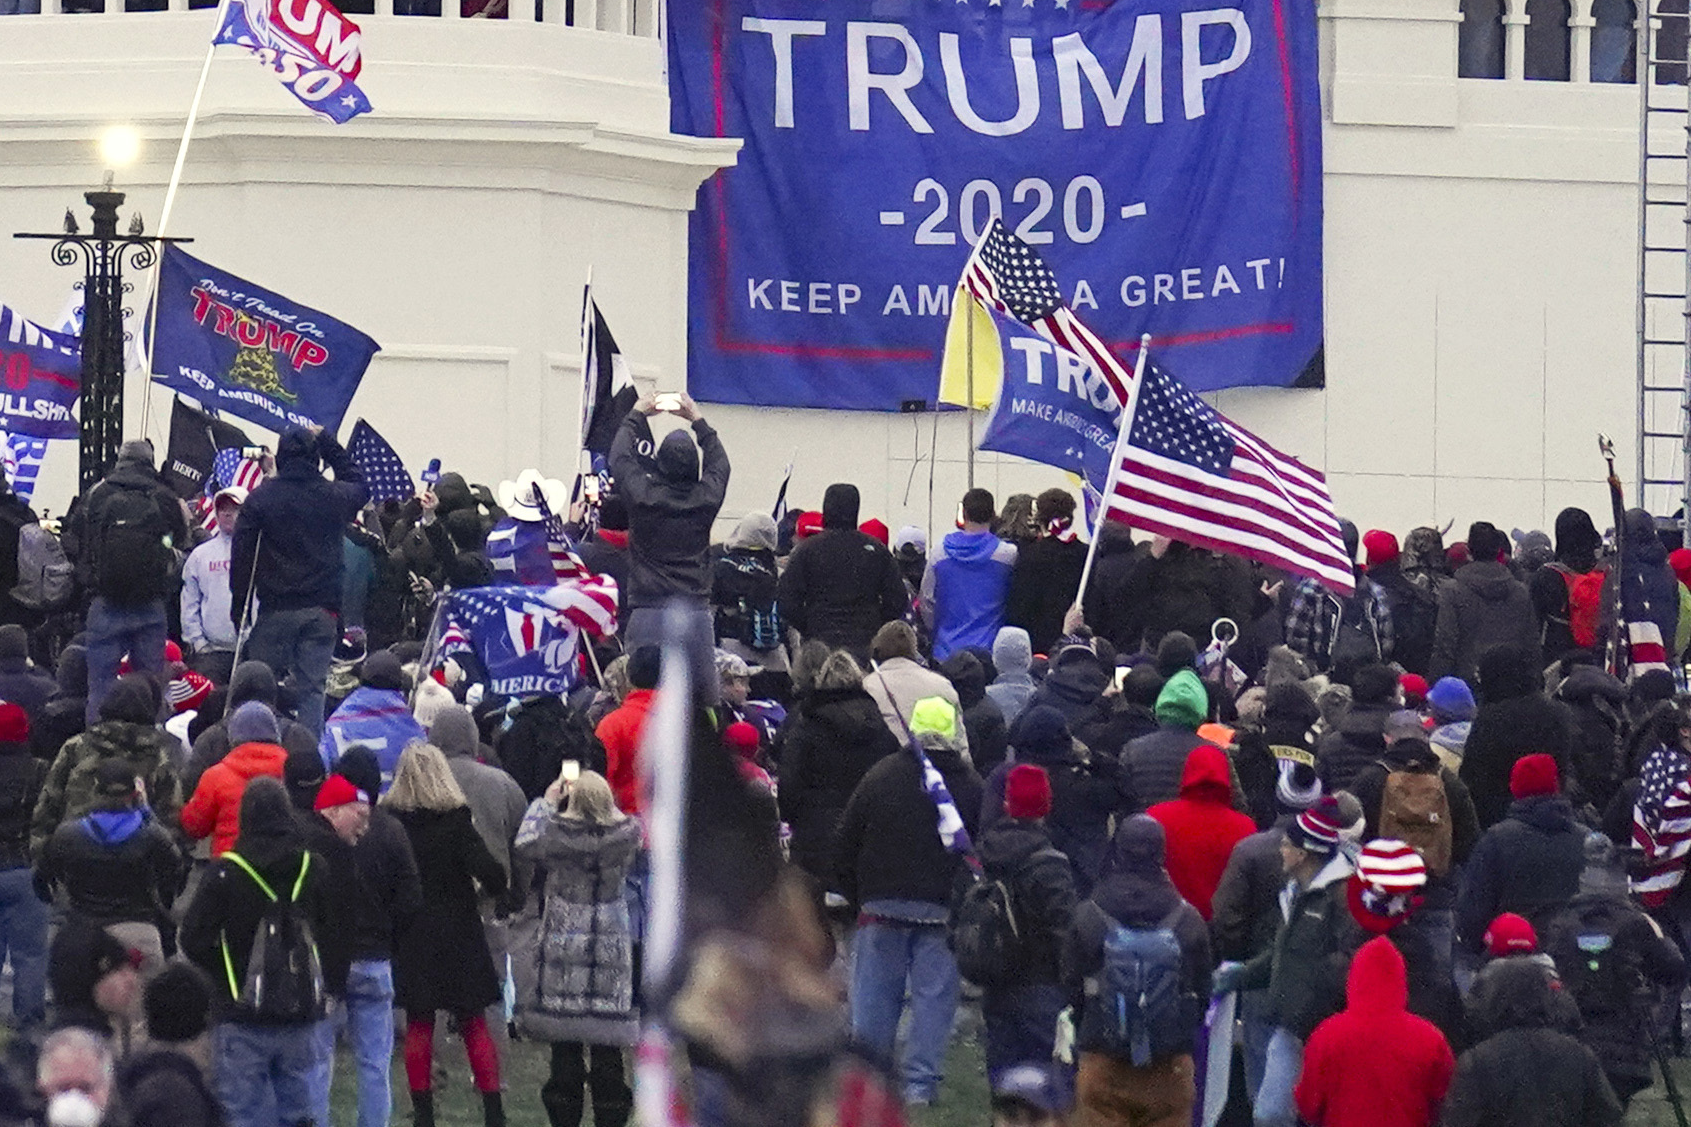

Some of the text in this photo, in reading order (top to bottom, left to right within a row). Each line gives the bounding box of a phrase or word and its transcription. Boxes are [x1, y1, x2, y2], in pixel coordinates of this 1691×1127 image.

[741, 7, 1252, 136] TRUMP
[199, 278, 325, 338] Don't Tread On
[747, 278, 861, 315] KEEP
[1120, 258, 1286, 309] GREAT!
[190, 285, 329, 372] TRUMP
[178, 365, 215, 391] KEEP
[217, 387, 286, 420] AMERICA
[1010, 336, 1122, 421] TRU
[1011, 397, 1054, 421] MAKE
[1083, 424, 1117, 455] GREA
